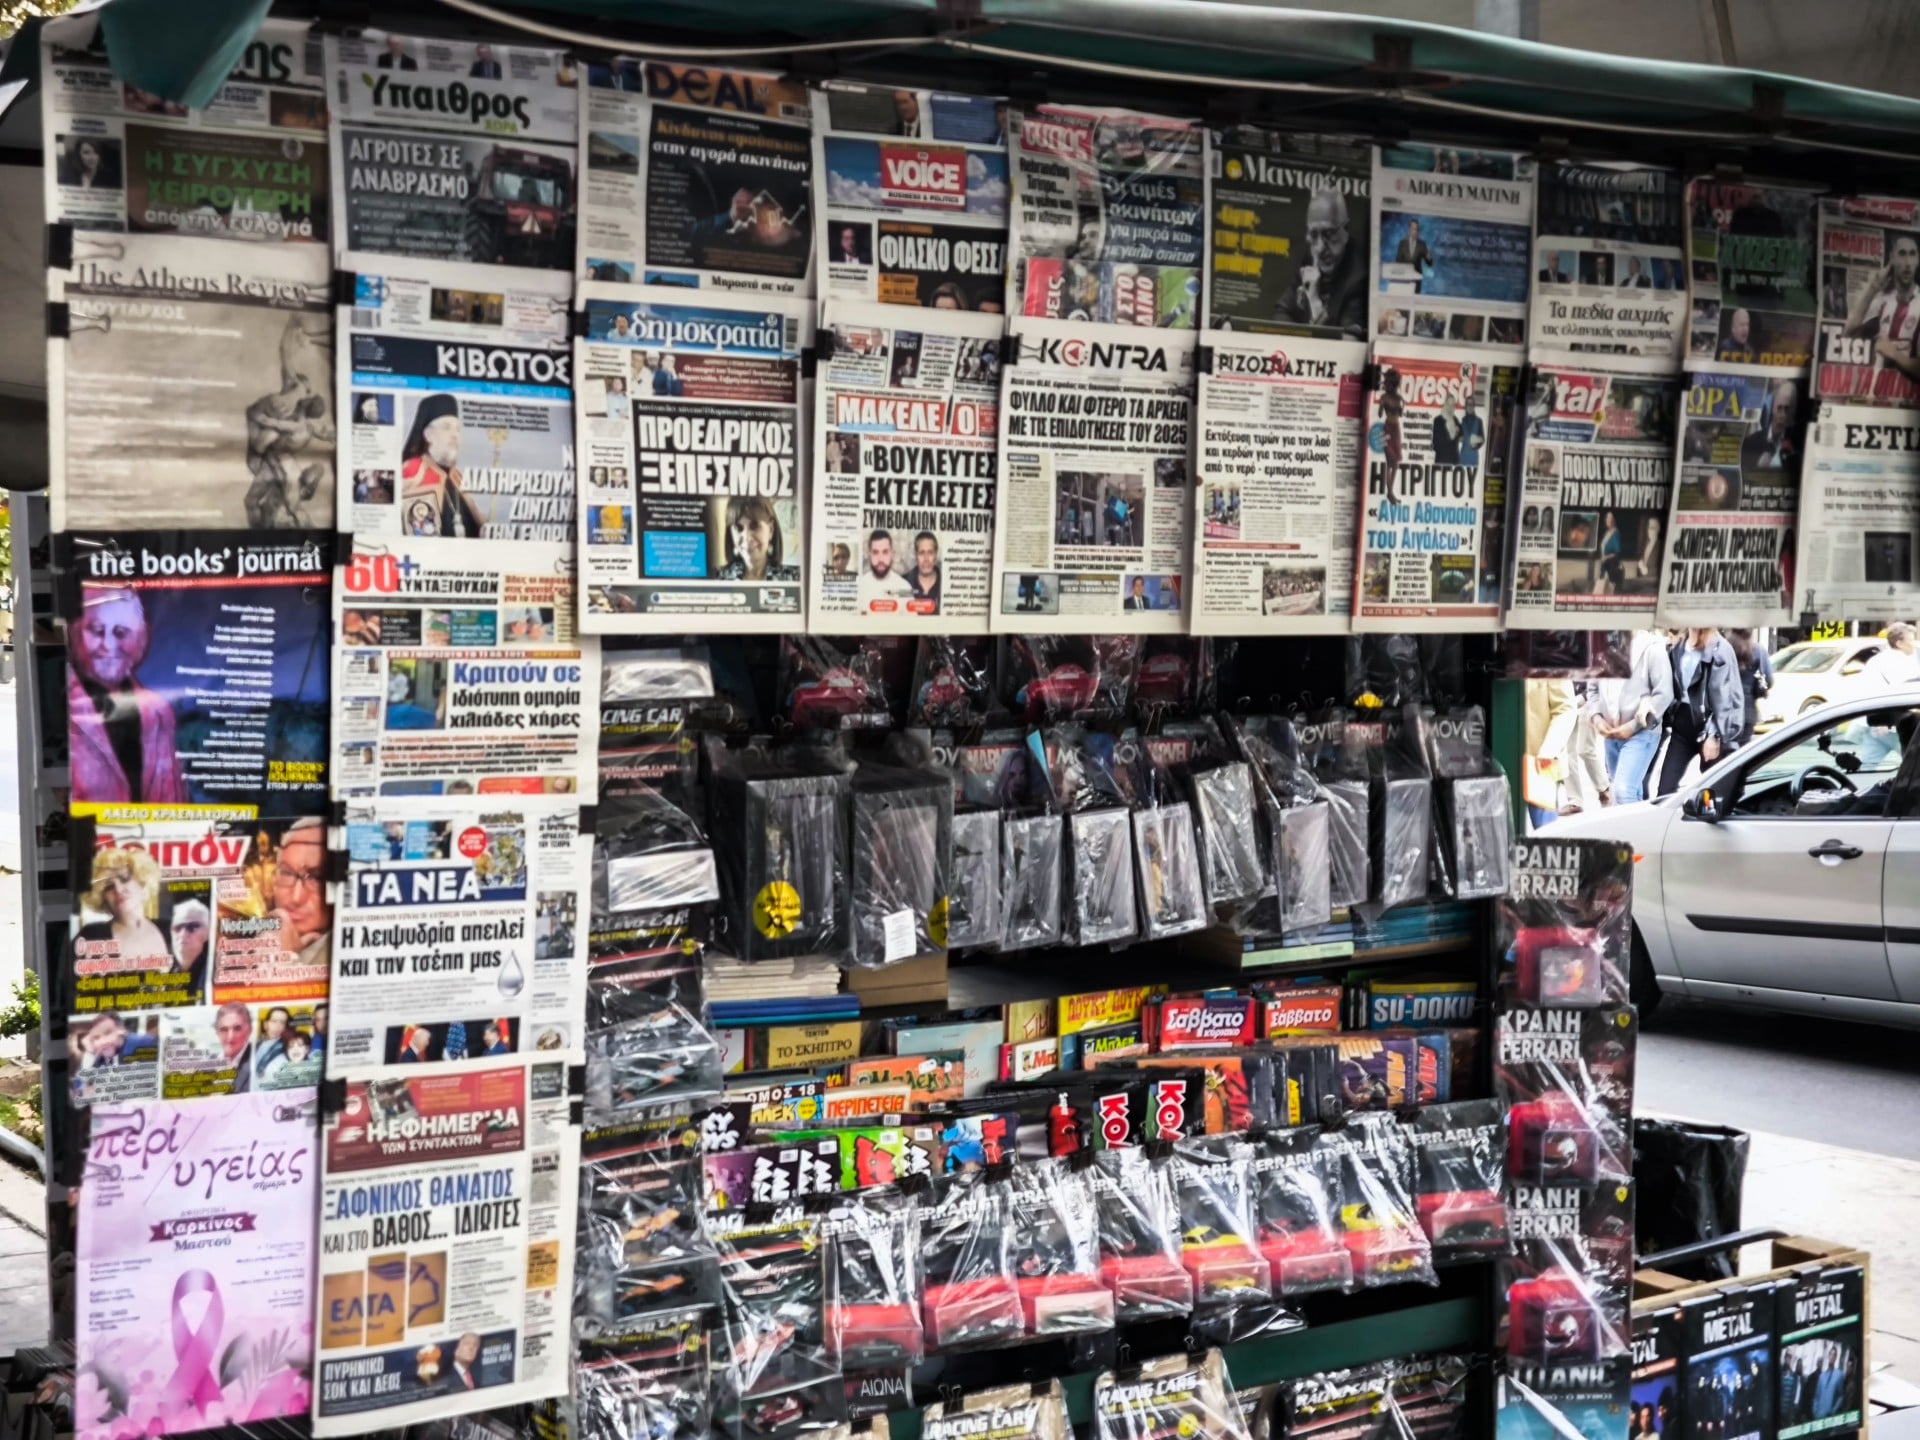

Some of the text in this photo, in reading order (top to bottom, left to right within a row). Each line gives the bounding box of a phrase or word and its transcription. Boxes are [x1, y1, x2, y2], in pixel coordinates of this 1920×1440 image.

[349, 137, 462, 170] ΑΓΡΟΤΕΣ ΣΕ
[652, 141, 810, 173] στην αγορά ακινήτων
[145, 151, 312, 186] Η ΣΥΓΧΥΣΗ
[885, 157, 961, 191] VOICE
[146, 181, 312, 214] ΧΕΙΡΟΤΕΡΗ
[350, 167, 470, 200] ΑΝΑΒΡΑΣΜΟ
[888, 191, 921, 202] BUSINESS
[930, 194, 960, 204] POLITICS
[1130, 182, 1177, 201] τιμές
[1406, 178, 1521, 206] ΑΠΟΓΕΥΜΑΤΙΝΗ
[1108, 201, 1196, 226] ακινήτων
[1109, 223, 1192, 244] για μικρά και
[879, 235, 1009, 275] ΦΙΑΣΚΟ ΦΕΣΣ
[78, 261, 309, 301] The Athens Review
[1549, 300, 1673, 326] Τα πεδία αιχμής
[629, 310, 780, 353] δημοκρατία
[1542, 324, 1559, 337] της
[1561, 323, 1614, 339] ελληνικής
[1821, 324, 1871, 366] Έχει
[436, 344, 571, 385] ΚΙΒΩΤΟΣ
[1040, 337, 1168, 372] KONTRA
[1218, 350, 1338, 379] ΡΙΖΟΣΠΑΣΤΗΣ
[1010, 390, 1188, 422] ΦΥΛΛΟ ΚΑΙ ΦΤΕΡΟ ΤΑ ΑΡΧΕΙΑ
[1550, 374, 1603, 415] tar
[1687, 384, 1741, 418] ΩΡΑ
[638, 414, 794, 455] ΠΡΟΕΔΡΙΚΟΣ
[1008, 415, 1027, 435] ΜΕ
[1029, 417, 1047, 437] ΤΙΣ
[1049, 419, 1126, 441] ΕΠΙΔΟΤΗΣΕΙΣ
[1128, 423, 1151, 443] ΤΟΥ
[1153, 424, 1188, 445] 2025
[1204, 428, 1332, 448] Εκτόξευση τιμών για τον λαό
[1205, 446, 1330, 465] και κερδών για τους ομίλους
[1563, 454, 1671, 484] ΠΟΙΟΙ ΣΚΟΤΩΣΑΝ
[640, 451, 794, 497] ΞΕΠΕΣΜΟΣ
[1204, 462, 1223, 474] από
[1224, 464, 1235, 473] το
[1236, 463, 1257, 476] νερό
[1264, 466, 1314, 479] εμπόρευμα
[1369, 461, 1387, 496] Η
[864, 476, 996, 510] ΕΚΤΕΛΕΣΤΕΣ
[1562, 482, 1580, 507] ΤΗ
[1580, 484, 1612, 508] ΧΗΡΑ
[863, 508, 937, 531] ΣΥΜΒΟΛΑΙΩΝ
[1412, 500, 1477, 526] Αθανασία
[1367, 528, 1398, 549] του
[1729, 528, 1779, 560] ΠΡΟΣΟΧΗ
[89, 545, 323, 579] the books' journal
[1668, 562, 1690, 594] ΣΤΑ
[453, 662, 581, 687] Κρατούν σε
[451, 689, 581, 709] ιδιότυπη ομηρία
[449, 711, 581, 730] χιλιάδες χήρες
[600, 708, 643, 725] CING
[1424, 718, 1485, 745] MOVIE
[360, 868, 482, 905] ΤΑ ΝΕΑ
[340, 926, 355, 949] Η
[360, 921, 455, 950] λειψυδρία
[461, 916, 525, 942] απειλεί
[339, 956, 369, 977] και
[375, 955, 406, 976] την
[411, 949, 464, 974] τσέπη
[470, 949, 502, 974] μας
[1269, 1008, 1333, 1028] Σάββατο
[1373, 994, 1476, 1023] SU-DOKU
[776, 1038, 853, 1058] ΤΟ ΣΚΗΠΤΡΟ
[1501, 1039, 1581, 1061] FERRARI
[748, 1083, 816, 1102] ΟΜΟΣ 18
[366, 1122, 385, 1143] Η
[381, 1133, 483, 1156] ΤΩΝ ΣΥΝΤΑΚΤΩΝ
[1414, 1128, 1474, 1146] ERRARI
[93, 1113, 308, 1200] περί υγείας
[1256, 1150, 1312, 1173] ERRARI
[325, 1167, 515, 1221] ΞΑΦΝΙΚΟΣ ΘΑΝΑΤΟΣ
[163, 1211, 246, 1237] Καρκίνος
[323, 1197, 522, 1254] ΚΑΙ ΣΤΟ ΒΑΘΟΣ... ΙΔΙΩΤΕΣ
[173, 1235, 232, 1253] Μαστού
[330, 1291, 397, 1324] ΕΛΤΑ
[1794, 1291, 1845, 1325] METAL
[1703, 1311, 1755, 1345] METAL
[1632, 1336, 1660, 1364] TAL
[324, 1355, 385, 1381] ΠΥΡΗΝΙΚΟ
[323, 1372, 403, 1401] ΣΟΚ ΚΑΙ ΔΕΟΣ
